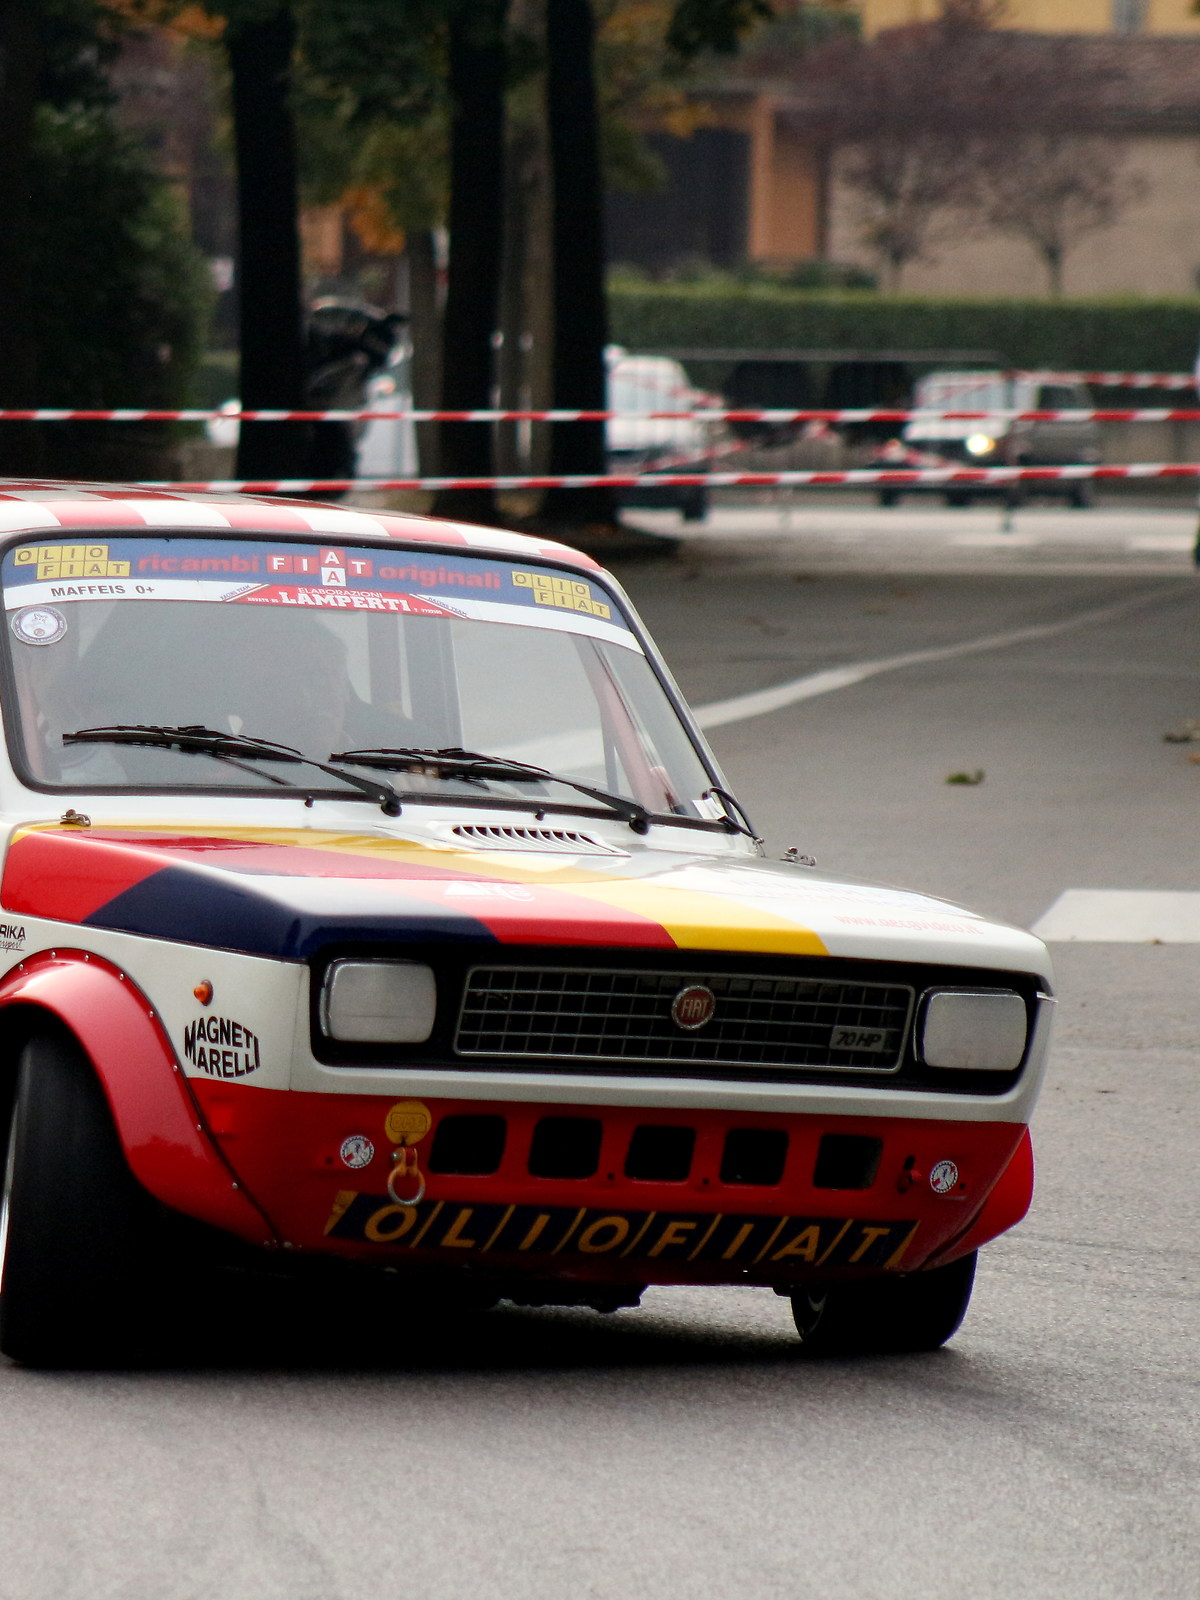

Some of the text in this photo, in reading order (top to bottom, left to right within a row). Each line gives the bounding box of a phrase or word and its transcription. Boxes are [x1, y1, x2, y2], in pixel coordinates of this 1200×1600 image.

[18, 547, 103, 562] OLIO
[43, 563, 124, 577] FIAT
[138, 554, 258, 573] ricambi
[379, 565, 500, 588] originali
[51, 585, 125, 597] MAFFEIS
[298, 587, 382, 598] ELABORAZIONI
[515, 573, 586, 595] OLIO
[279, 591, 411, 611] LAMPERTI
[540, 592, 606, 615] FIAT
[680, 999, 710, 1018] FIAT
